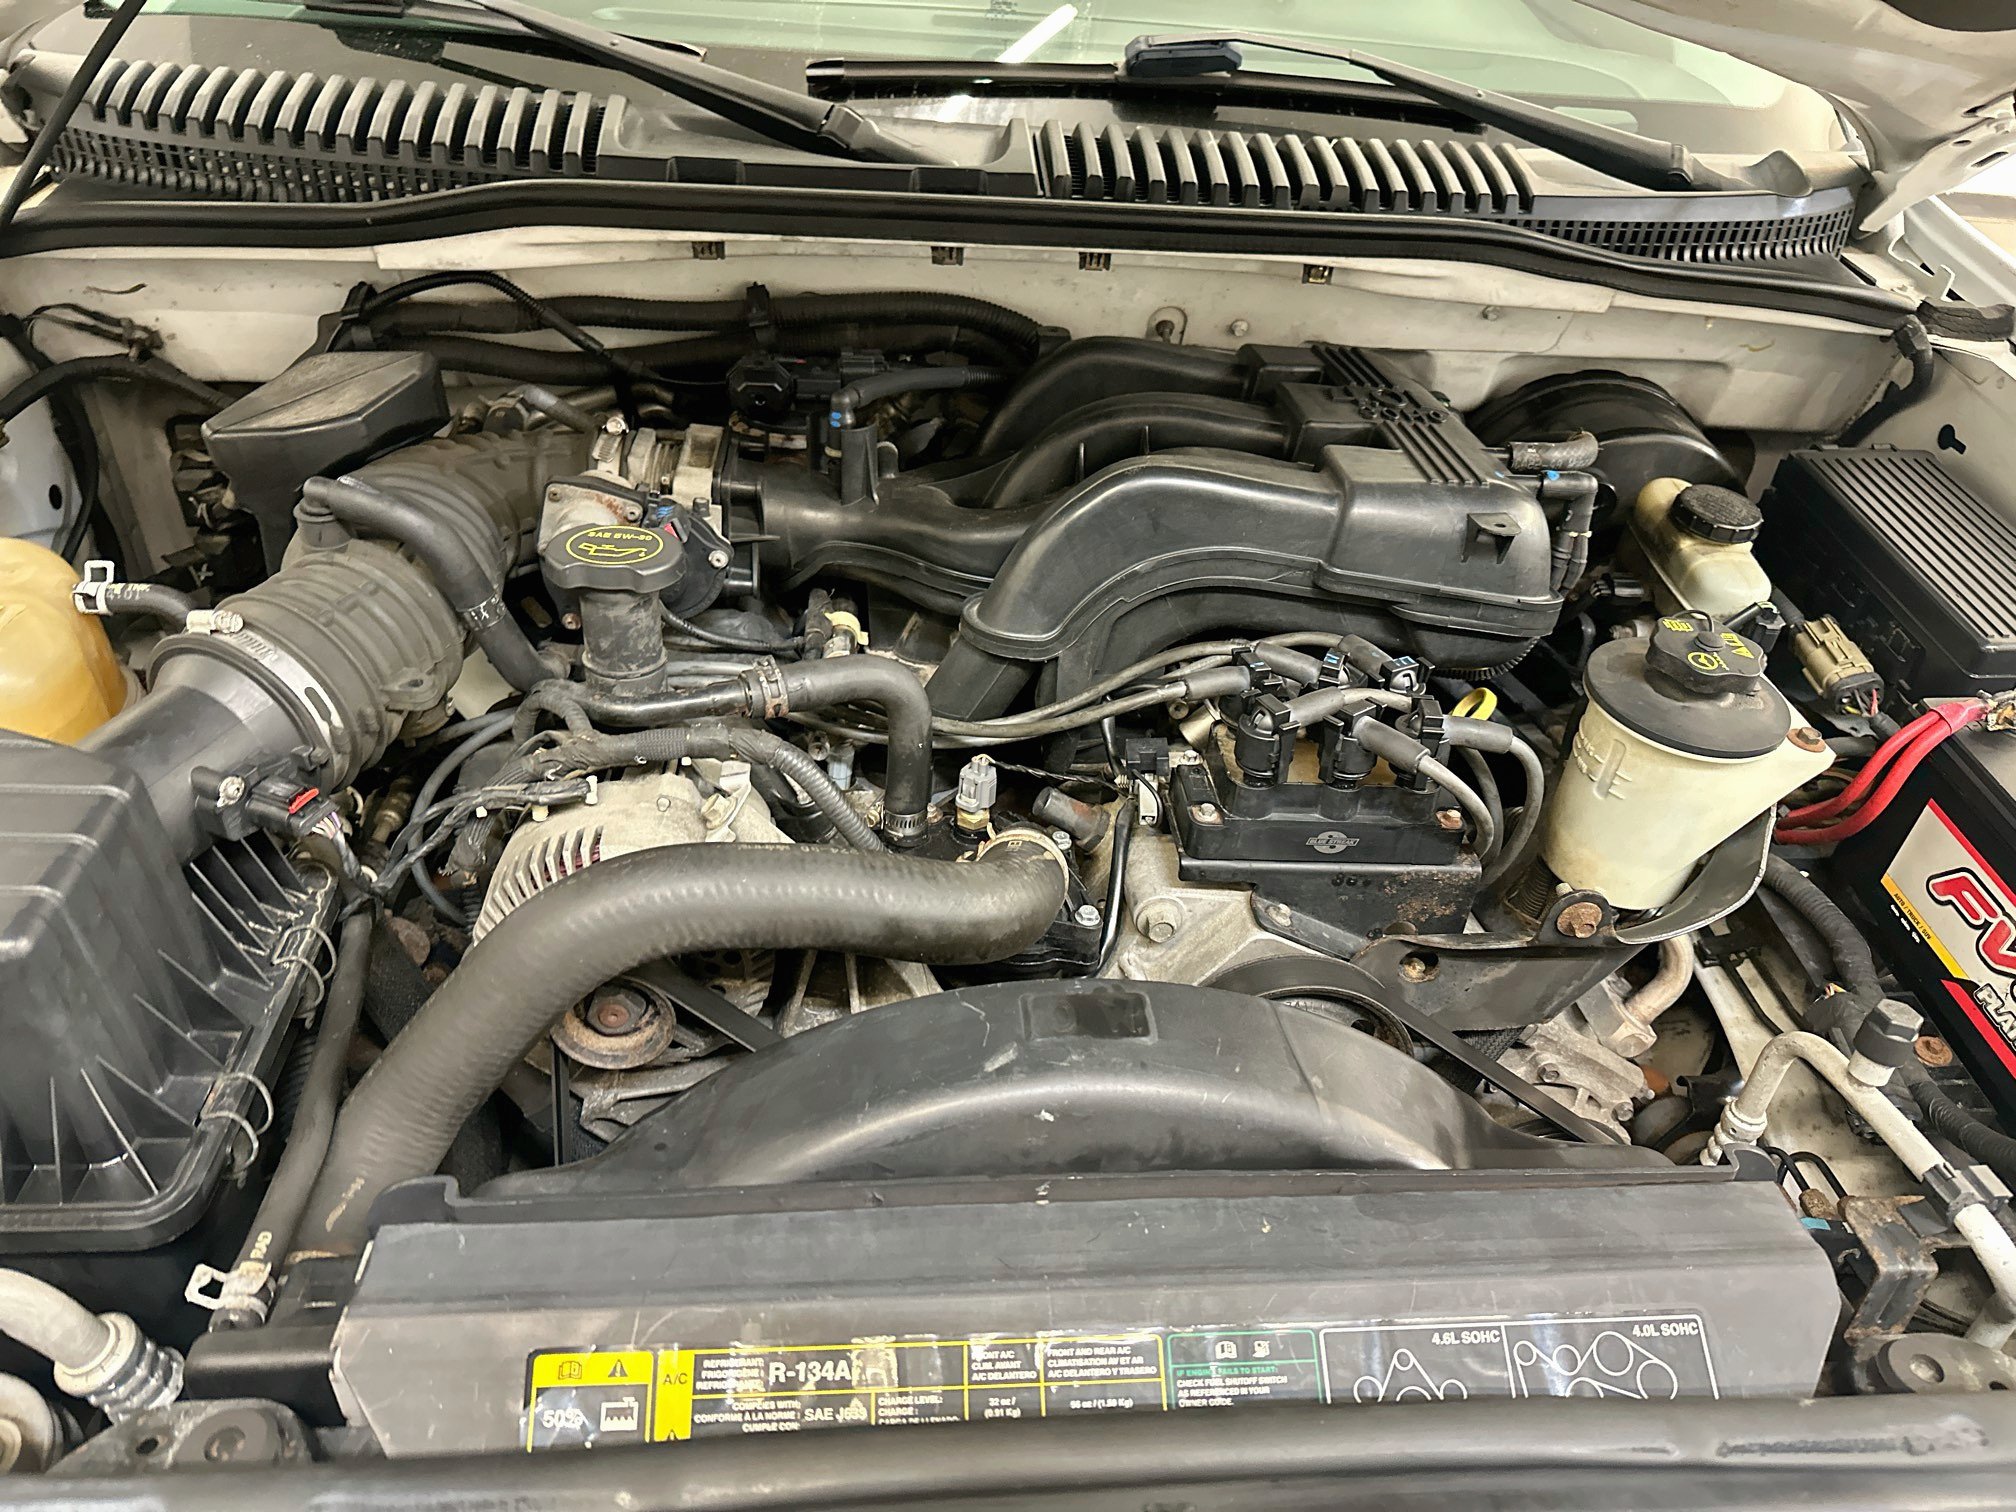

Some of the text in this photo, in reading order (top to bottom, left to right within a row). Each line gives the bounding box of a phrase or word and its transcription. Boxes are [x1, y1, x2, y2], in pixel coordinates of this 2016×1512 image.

[587, 531, 612, 539] SAE
[1893, 893, 1905, 907] AUTO
[1907, 909, 1921, 926] TRUCK
[1922, 929, 1931, 939] SUV
[1927, 868, 2016, 974] FV
[1633, 1322, 1699, 1338] 4.0L SOHC
[1432, 1330, 1501, 1346] 4.6L SOHC
[971, 1350, 1016, 1360] FONT A/C
[1047, 1346, 1132, 1357] FRONT AND REAR A/C
[769, 1359, 851, 1383] R-134A
[972, 1371, 1038, 1381] A/C DELANTERO
[1048, 1369, 1062, 1378] A/C
[1063, 1367, 1111, 1377] DELANTERO
[1112, 1367, 1118, 1375] Y
[1186, 1368, 1217, 1377] ENGIN
[663, 1373, 688, 1385] A/C
[1177, 1376, 1288, 1388] CHECK FUEL SHUTOFF SWITCH
[1178, 1386, 1270, 1398] AS REFERENCED IN YOUR
[878, 1395, 914, 1406] CHARGE
[1178, 1398, 1207, 1407] OWNER
[694, 1412, 743, 1424] CONFORME
[752, 1412, 764, 1421] LA
[804, 1408, 833, 1421] SAE
[878, 1407, 914, 1417] CHARGE
